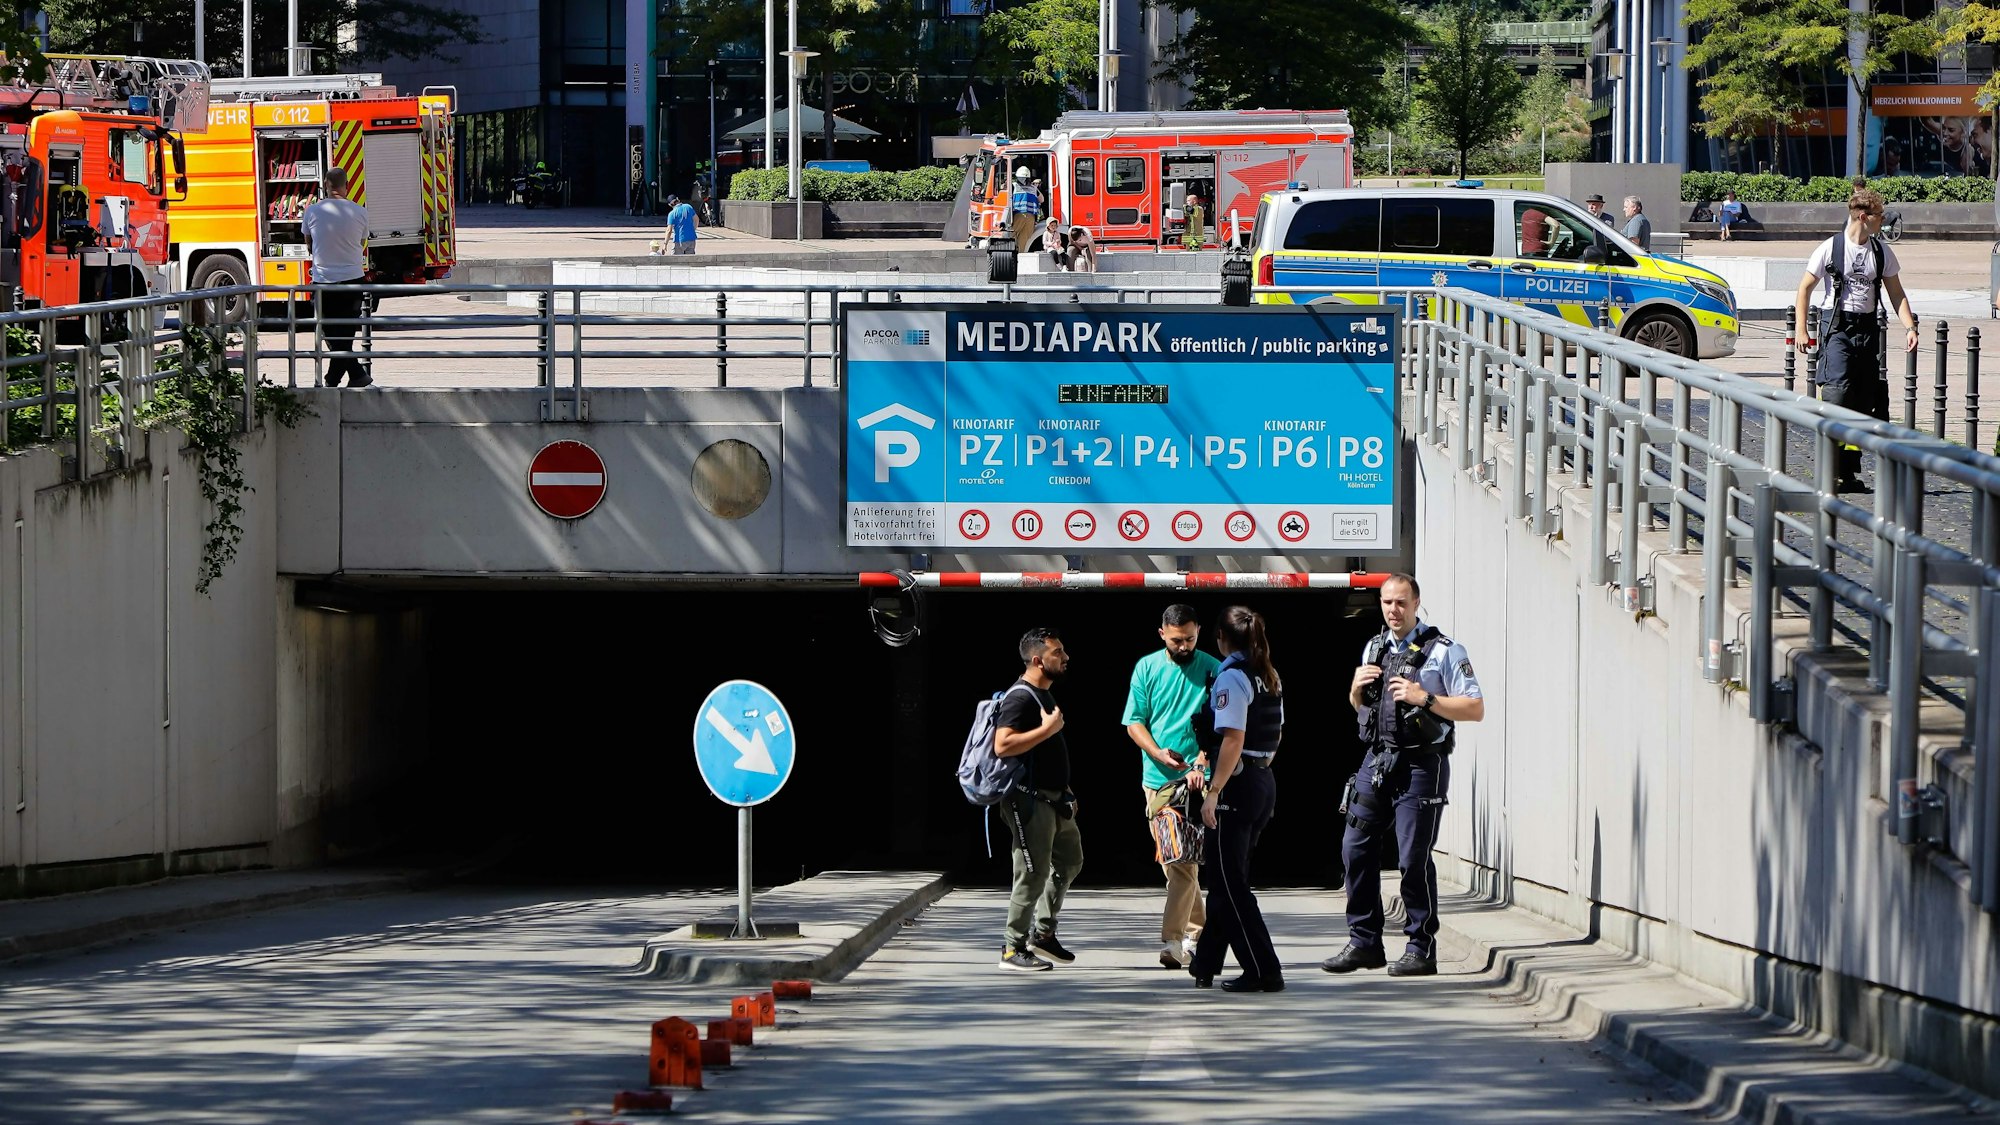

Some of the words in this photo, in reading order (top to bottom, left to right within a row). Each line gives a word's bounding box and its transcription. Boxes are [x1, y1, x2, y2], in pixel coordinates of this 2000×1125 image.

[1874, 97, 1906, 105] HERZLICH
[1907, 97, 1962, 105] WILLKOMMEN
[287, 107, 310, 123] 112
[1233, 153, 1249, 162] 112
[1525, 278, 1589, 294] POLIZEI
[864, 330, 900, 338] APCOA
[957, 322, 1162, 353] MEDIAPARK
[1170, 337, 1246, 353] öffentlich
[1263, 338, 1311, 356] public
[1316, 338, 1376, 356] parking
[863, 338, 900, 346] PARKING
[1060, 385, 1167, 402] EINFAHRT
[953, 419, 1015, 430] KINOTARIF
[1038, 419, 1101, 430] KINOTARIF
[1264, 420, 1326, 431] KINOTARIF
[875, 430, 921, 483] P
[960, 435, 1003, 466] PZ
[1026, 435, 1113, 467] P1+2
[1134, 435, 1180, 468] P4
[1204, 436, 1247, 469] P5
[1272, 436, 1318, 468] P6
[1339, 436, 1384, 468] P8
[1049, 476, 1091, 485] CINEDOM
[1355, 473, 1383, 481] HOTEL
[853, 507, 914, 518] Anlieferung
[917, 507, 935, 516] frei
[854, 520, 915, 528] Taxivorfahrt
[918, 520, 935, 528] frei
[1020, 517, 1035, 532] 10
[1177, 521, 1197, 531] Erdgas
[1340, 518, 1355, 526] hier
[854, 532, 917, 540] Hotelvorfahrt
[919, 532, 935, 540] frei
[1340, 528, 1351, 536] die
